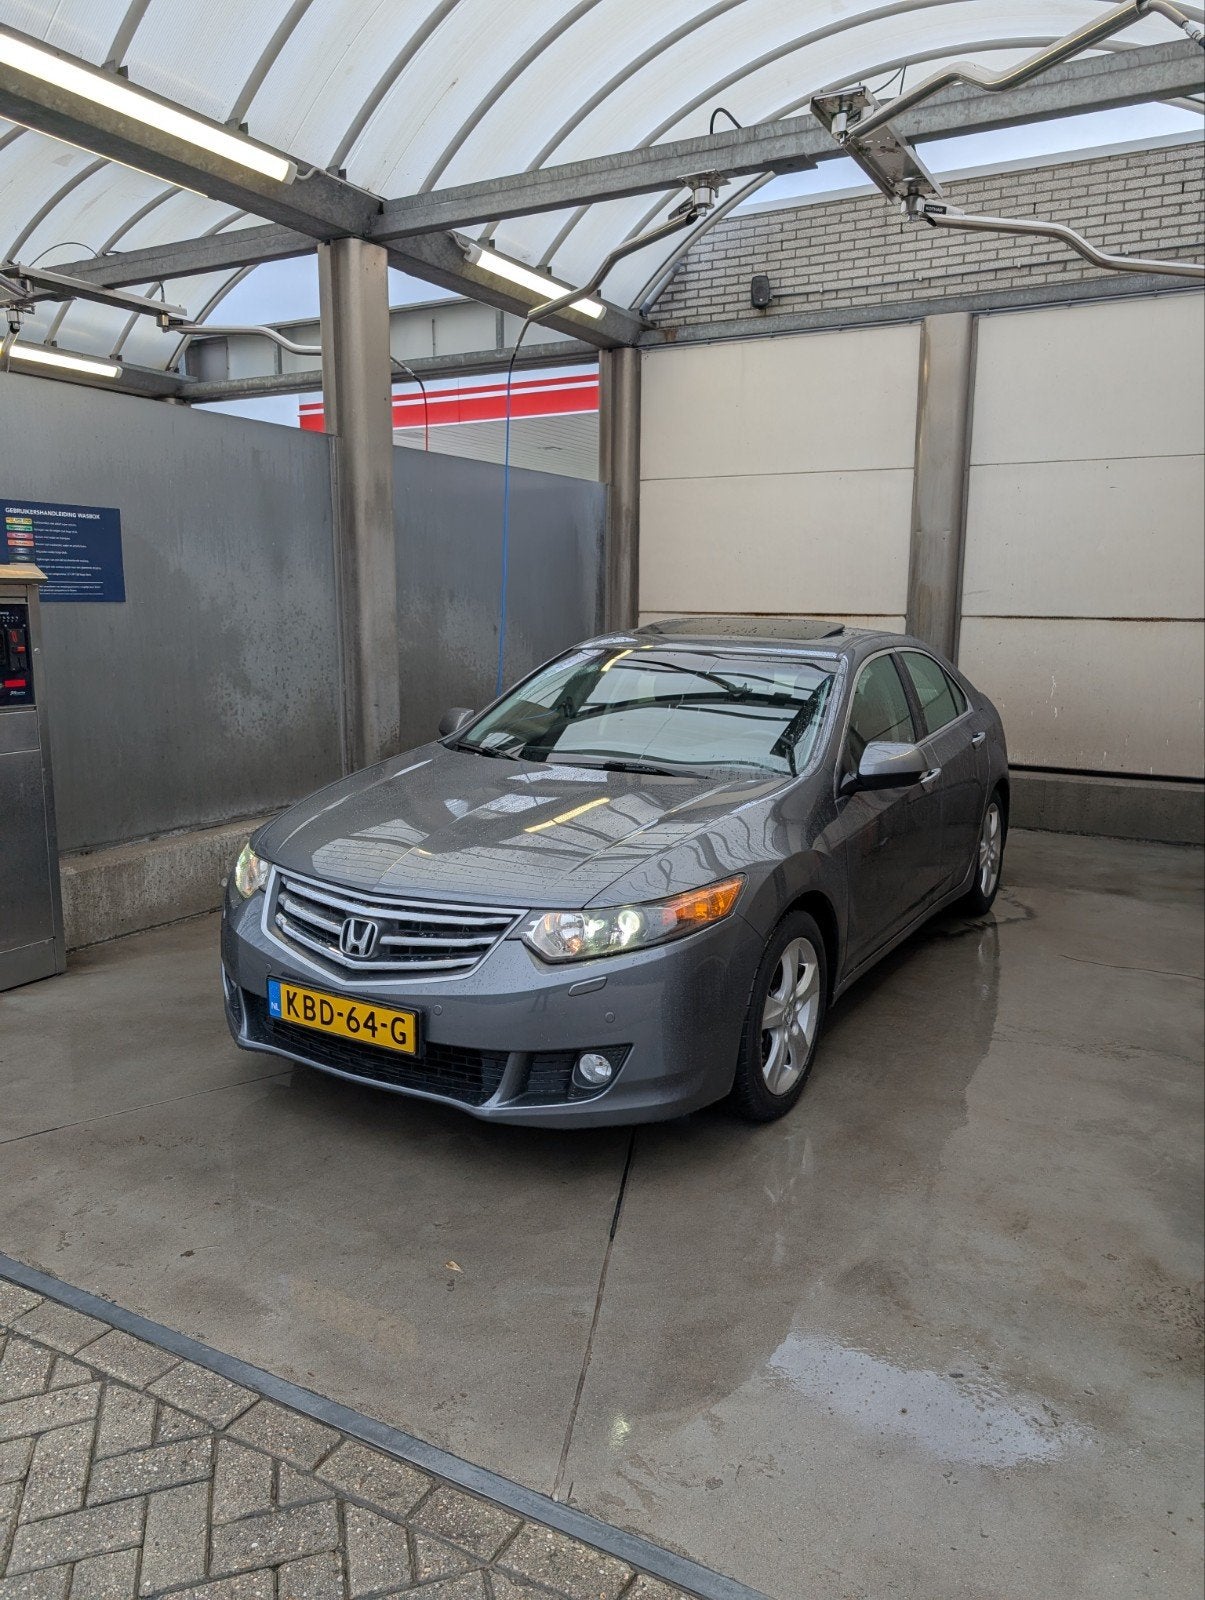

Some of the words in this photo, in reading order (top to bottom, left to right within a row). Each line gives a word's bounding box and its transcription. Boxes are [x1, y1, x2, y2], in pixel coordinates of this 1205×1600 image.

[5, 507, 77, 518] GEBRUIKERSHANDLEIDING
[271, 1001, 280, 1011] NL
[286, 990, 407, 1045] KBD-64-G
